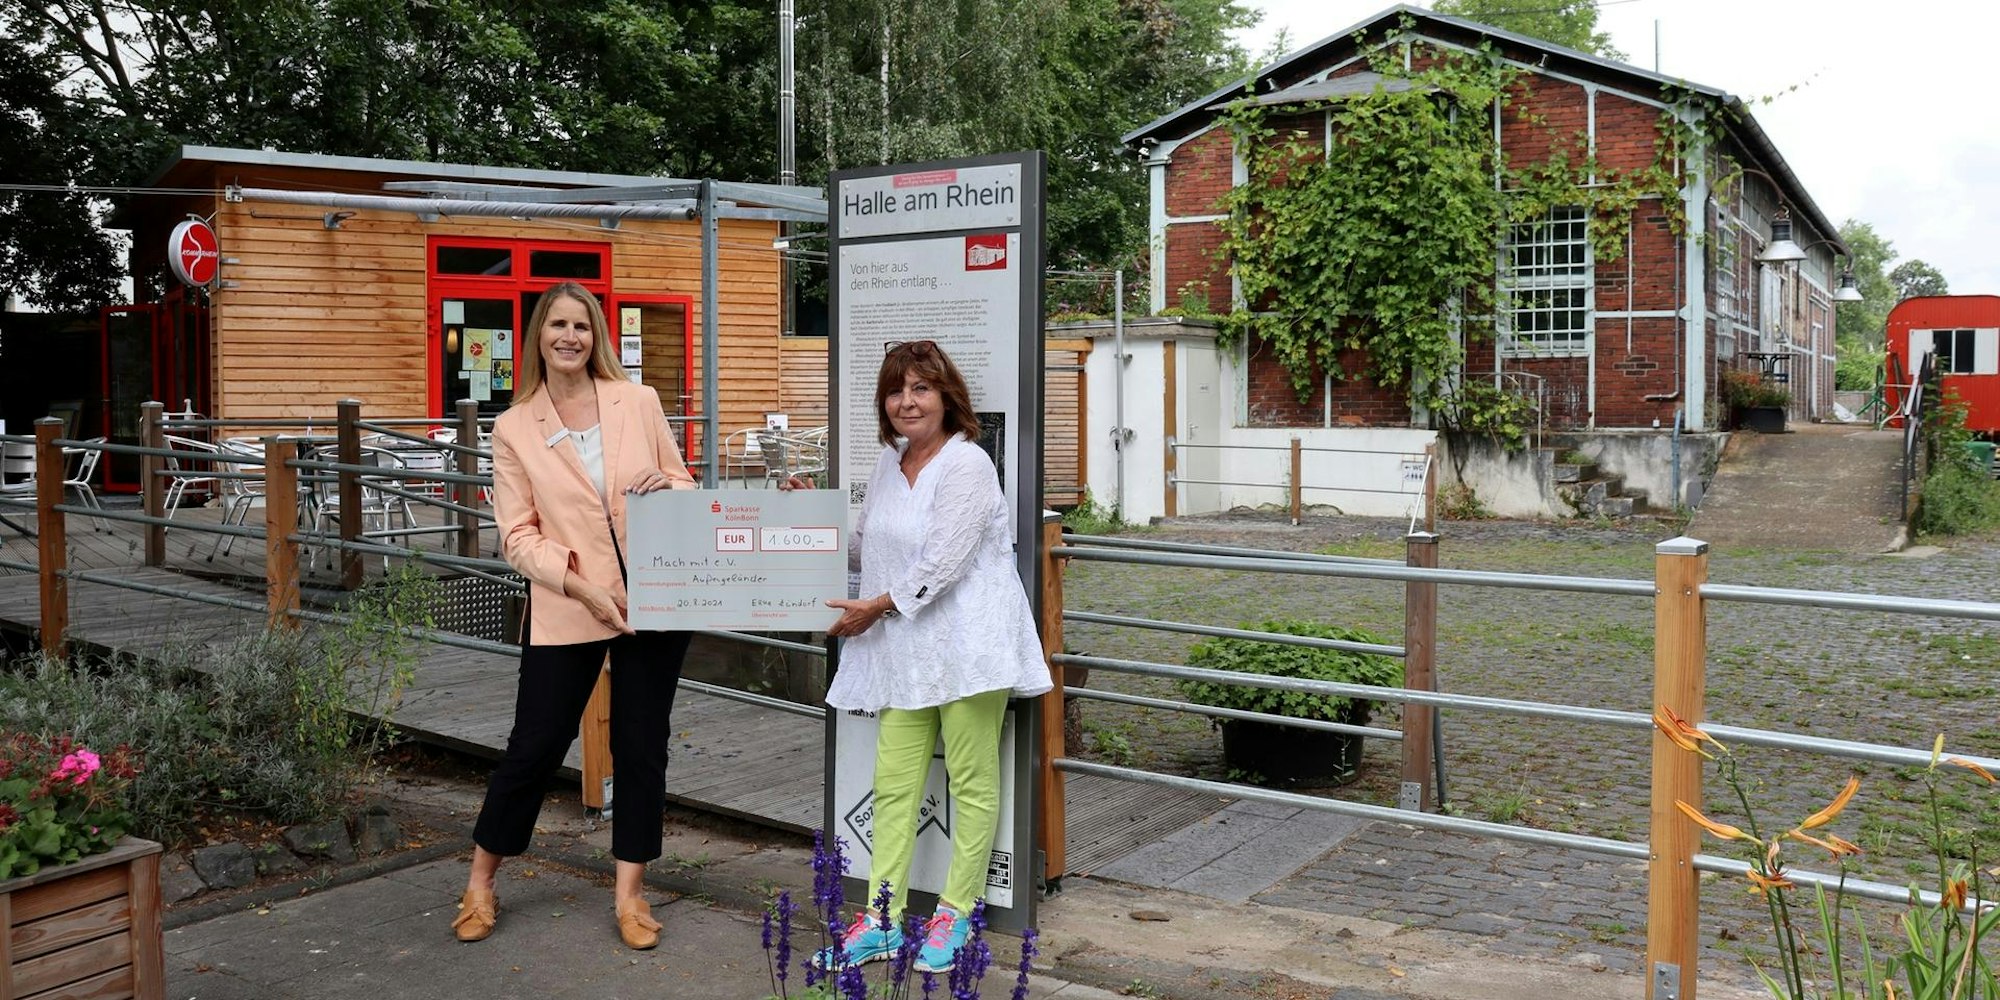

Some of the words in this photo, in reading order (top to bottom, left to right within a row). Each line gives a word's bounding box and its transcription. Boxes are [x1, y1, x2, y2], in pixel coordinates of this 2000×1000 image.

[845, 191, 897, 216] Halle
[904, 191, 937, 212] am
[947, 181, 1014, 208] Rhein
[850, 263, 869, 275] Von
[871, 262, 889, 274] hier
[891, 262, 909, 273] aus
[850, 278, 869, 291] den
[871, 277, 898, 289] Rhein
[901, 275, 938, 290] entlang
[725, 505, 760, 514] Sparkasse
[724, 534, 746, 544] EUR
[653, 556, 685, 568] Mach
[690, 556, 708, 567] mit
